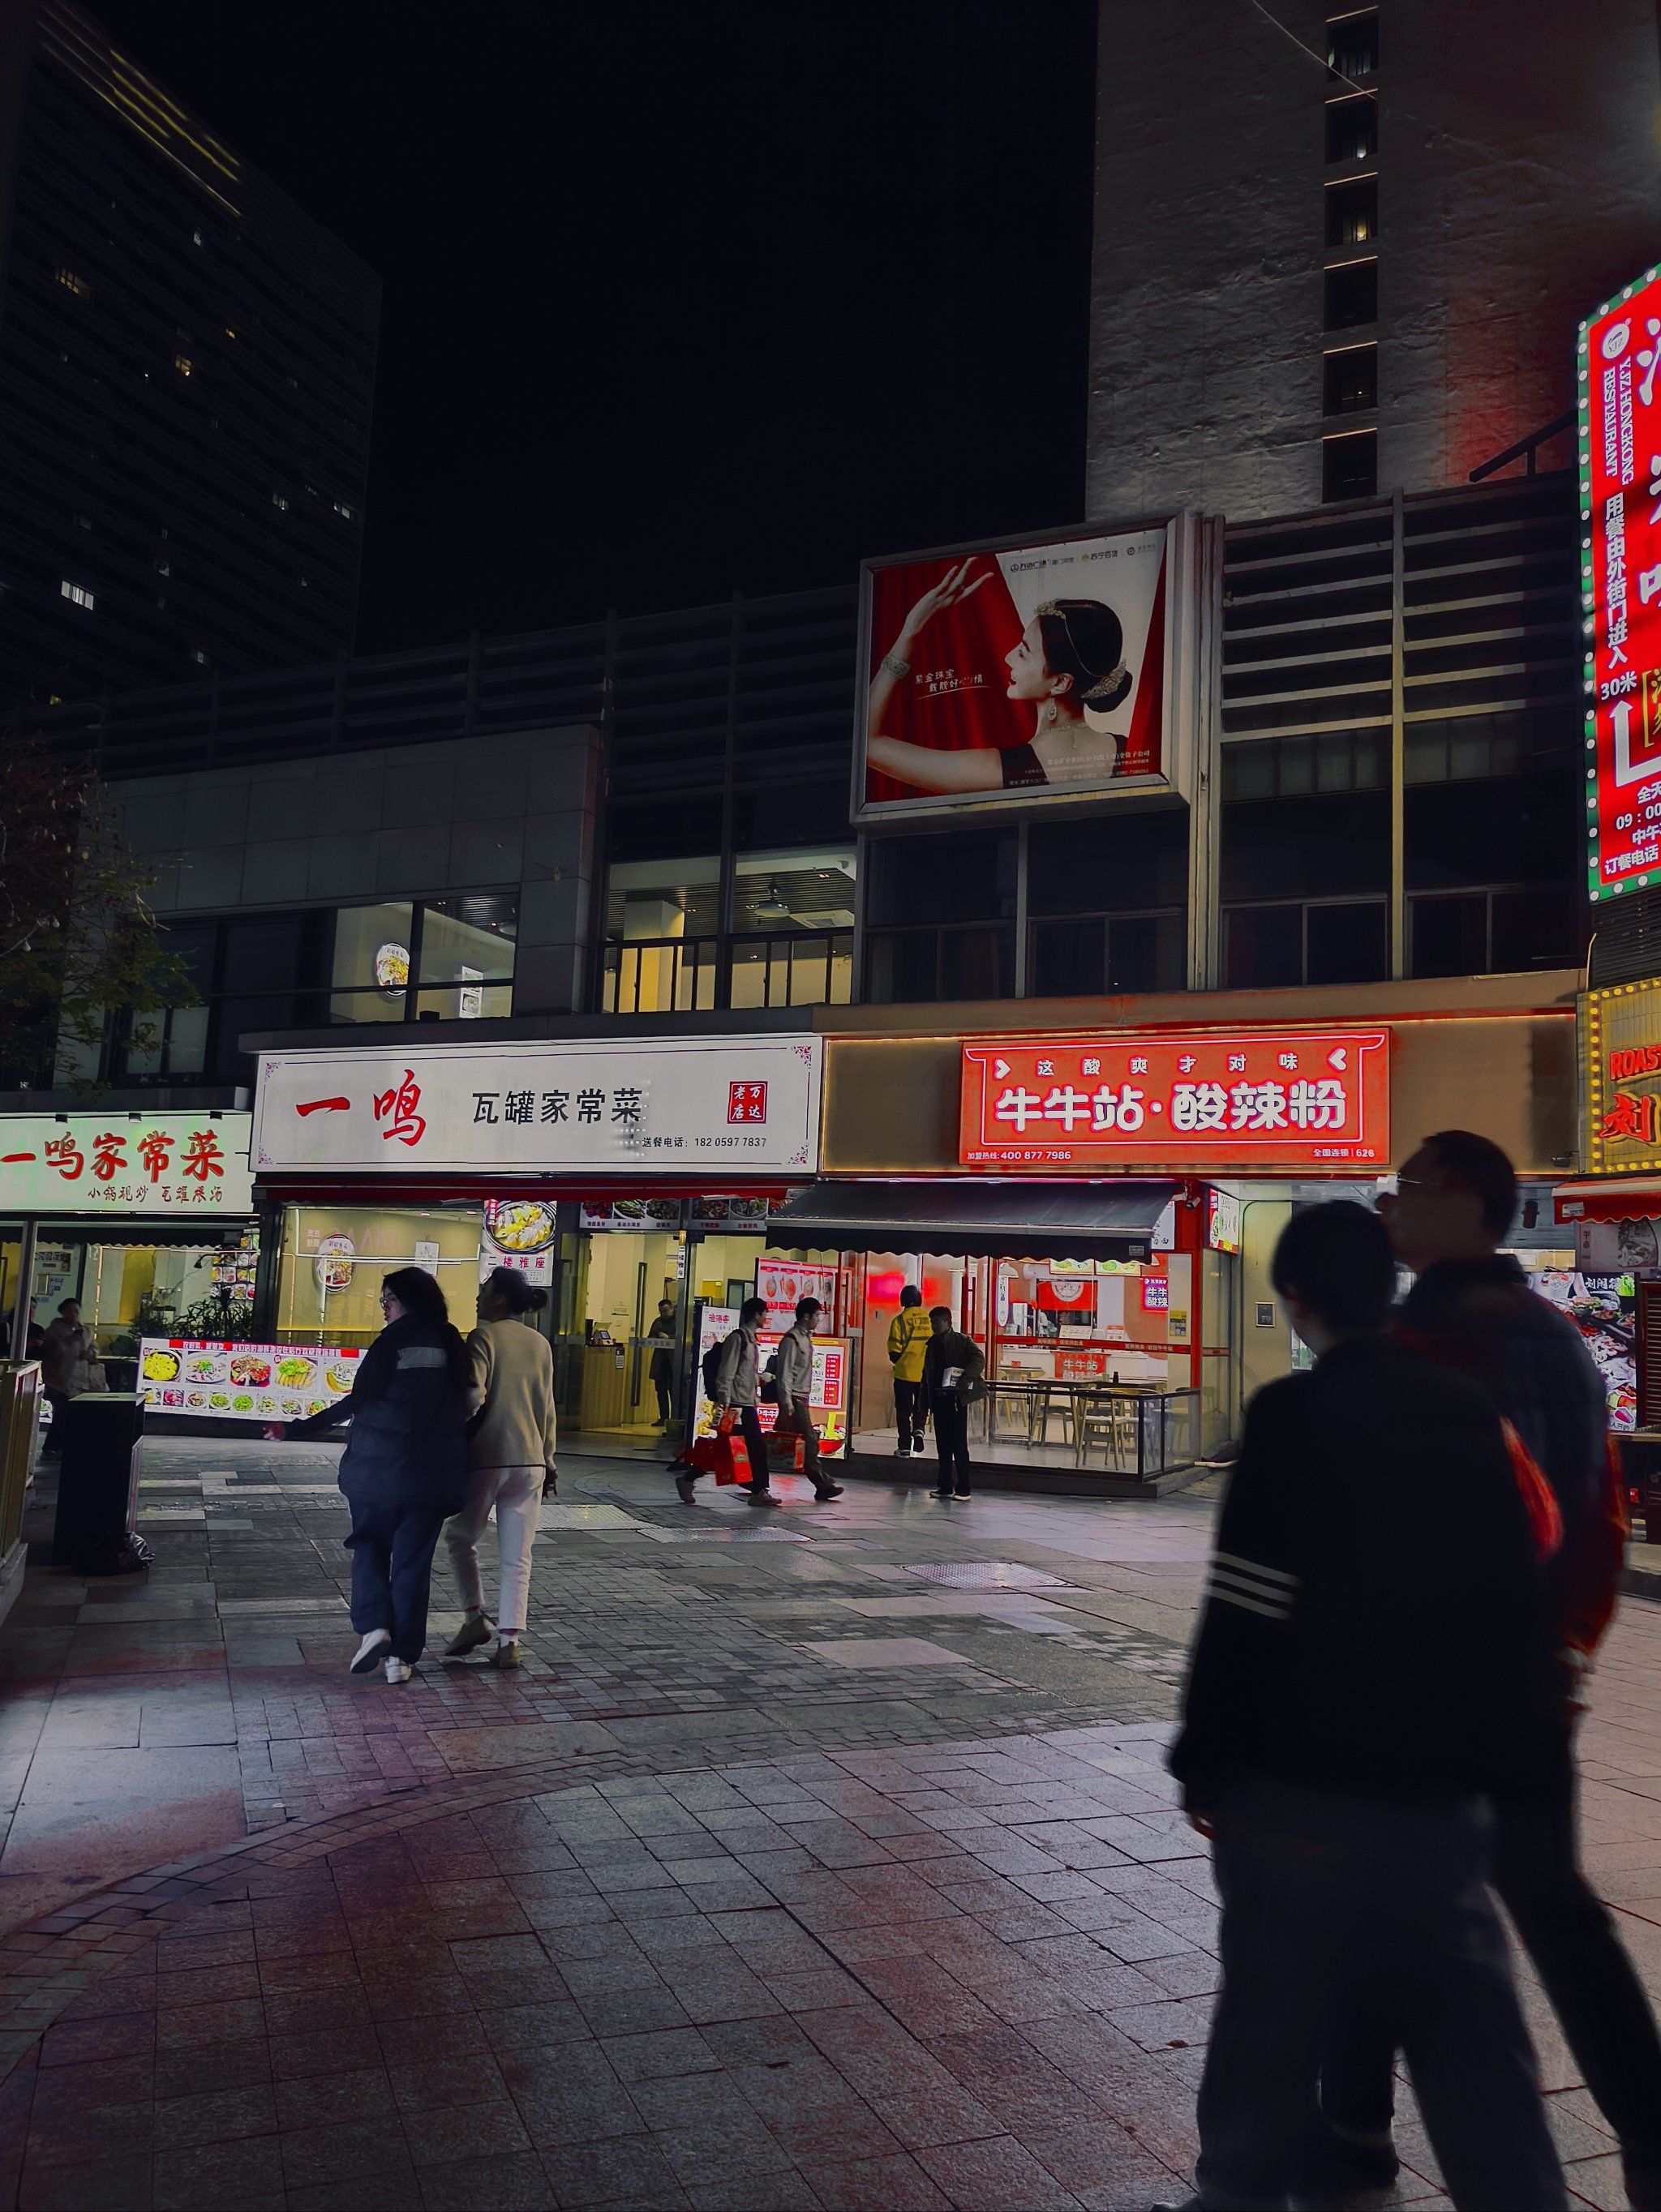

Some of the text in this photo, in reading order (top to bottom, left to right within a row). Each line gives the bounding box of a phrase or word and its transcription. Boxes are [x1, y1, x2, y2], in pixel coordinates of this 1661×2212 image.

[1603, 367, 1617, 477] RESTAURANT
[1090, 550, 1118, 560] 苏宁百货
[1605, 491, 1628, 670] 用餐由外街门进入
[1600, 671, 1637, 701] 30米
[1632, 823, 1661, 845] 中午
[1604, 844, 1659, 875] 订餐电话
[295, 1069, 427, 1147] 一鸣
[472, 1087, 644, 1126] 瓦罐家常菜
[694, 1137, 712, 1148] 182
[715, 1137, 740, 1148] 0597
[741, 1137, 768, 1148] 7837
[1024, 1150, 1044, 1161] 877
[1045, 1150, 1072, 1161] 7986
[0, 1128, 225, 1184] 一鸣家常菜
[87, 1185, 149, 1203] 小锅现炒
[487, 1256, 546, 1268] 二楼雅座
[1063, 1358, 1098, 1371] 牛牛站
